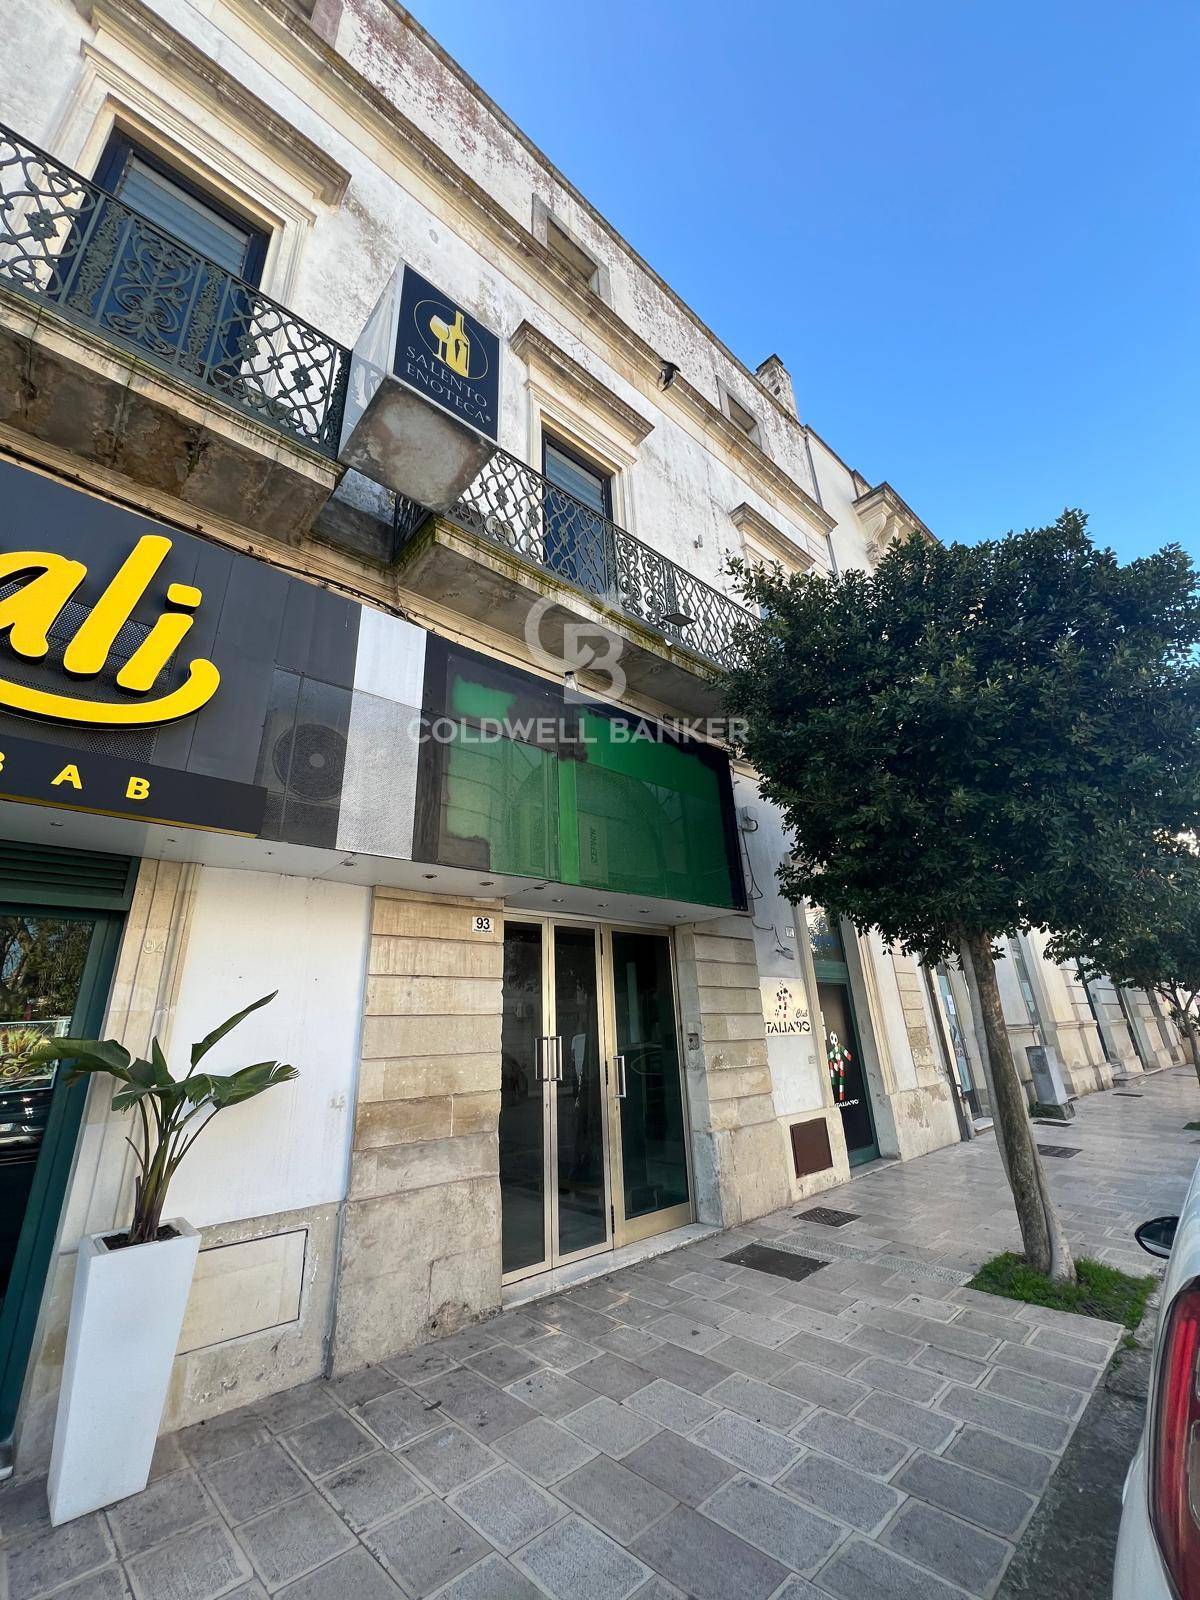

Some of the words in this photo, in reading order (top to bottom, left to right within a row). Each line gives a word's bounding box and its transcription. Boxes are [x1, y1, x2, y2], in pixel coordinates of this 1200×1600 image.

[406, 346, 487, 407] SALENTO
[0, 752, 150, 800] AB
[476, 917, 490, 930] 93
